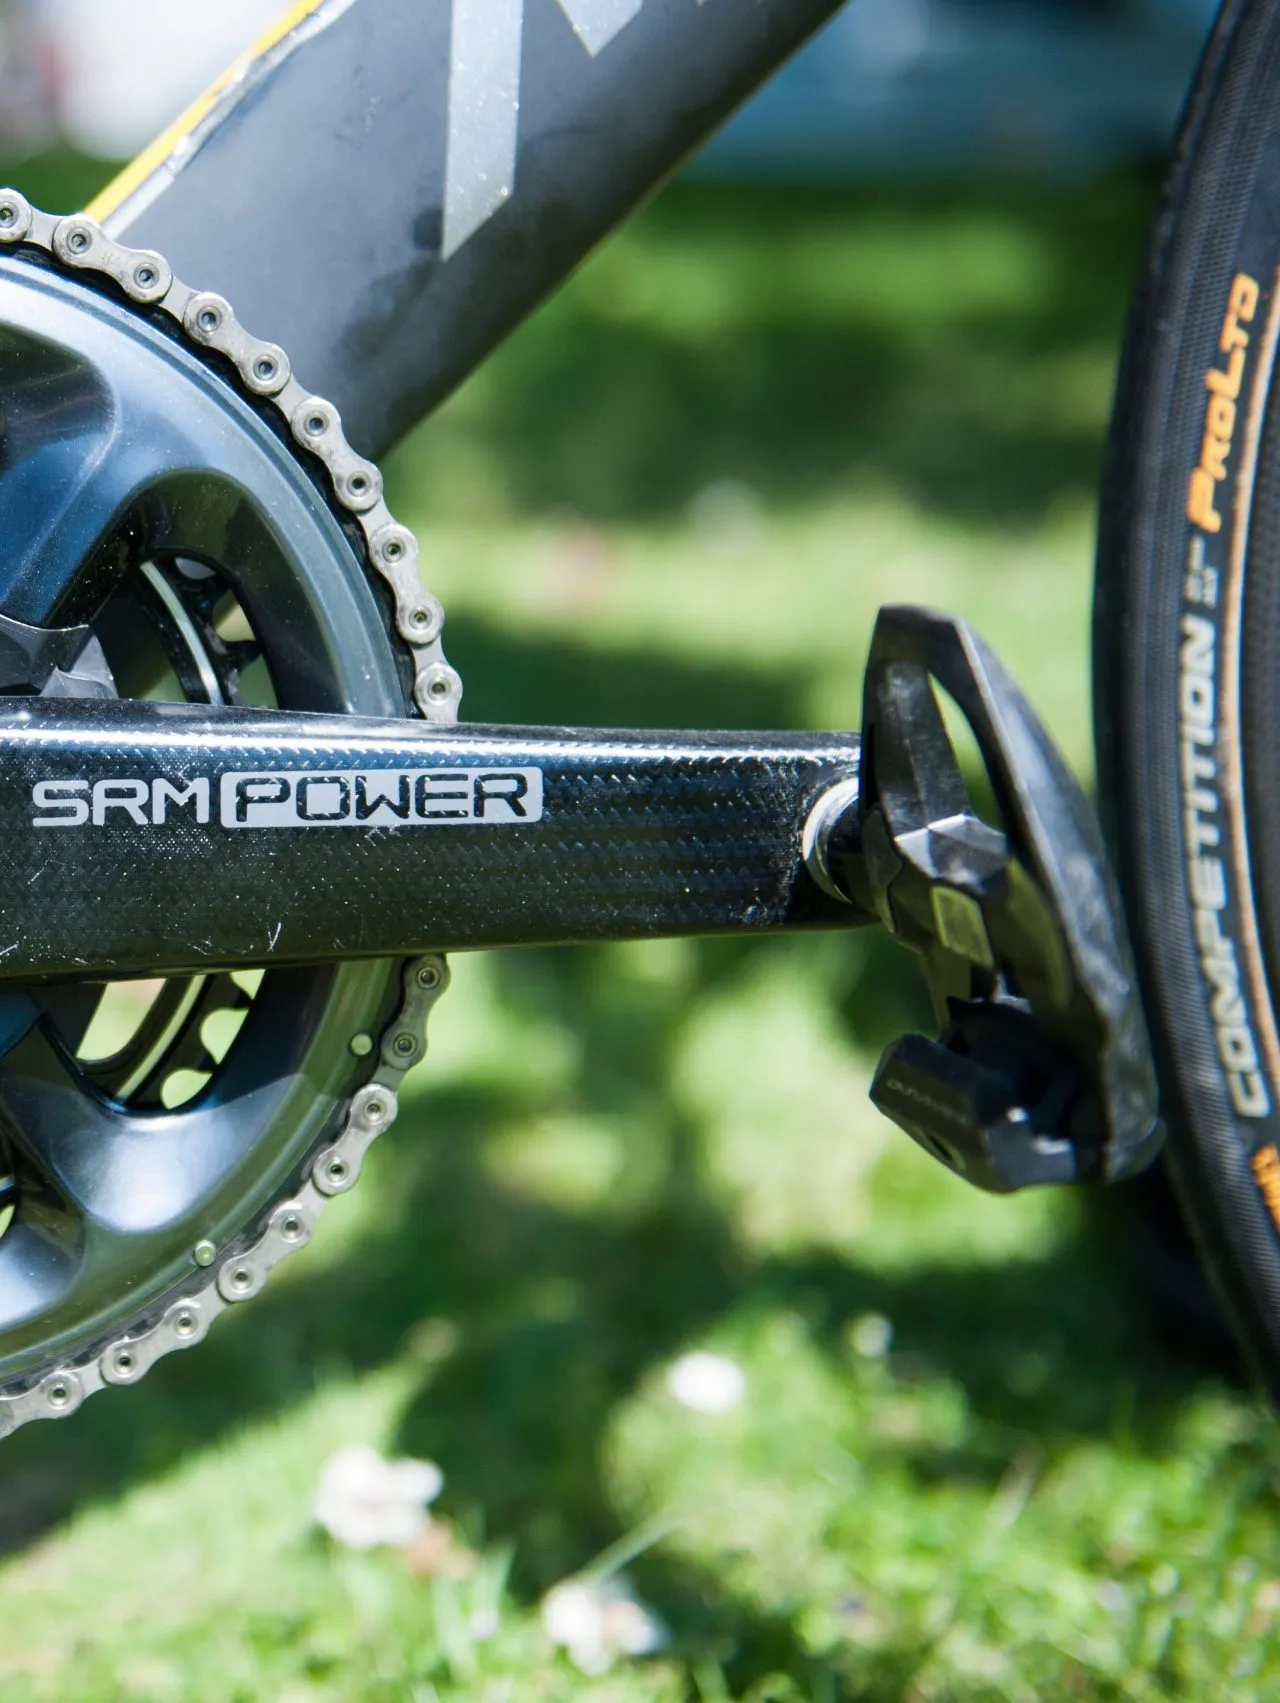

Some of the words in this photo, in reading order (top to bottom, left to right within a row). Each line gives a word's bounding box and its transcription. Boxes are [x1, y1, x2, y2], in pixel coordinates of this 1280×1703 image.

[32, 777, 210, 828] SRM
[235, 772, 530, 823] POWER
[1180, 613, 1269, 1118] COMPETITION
